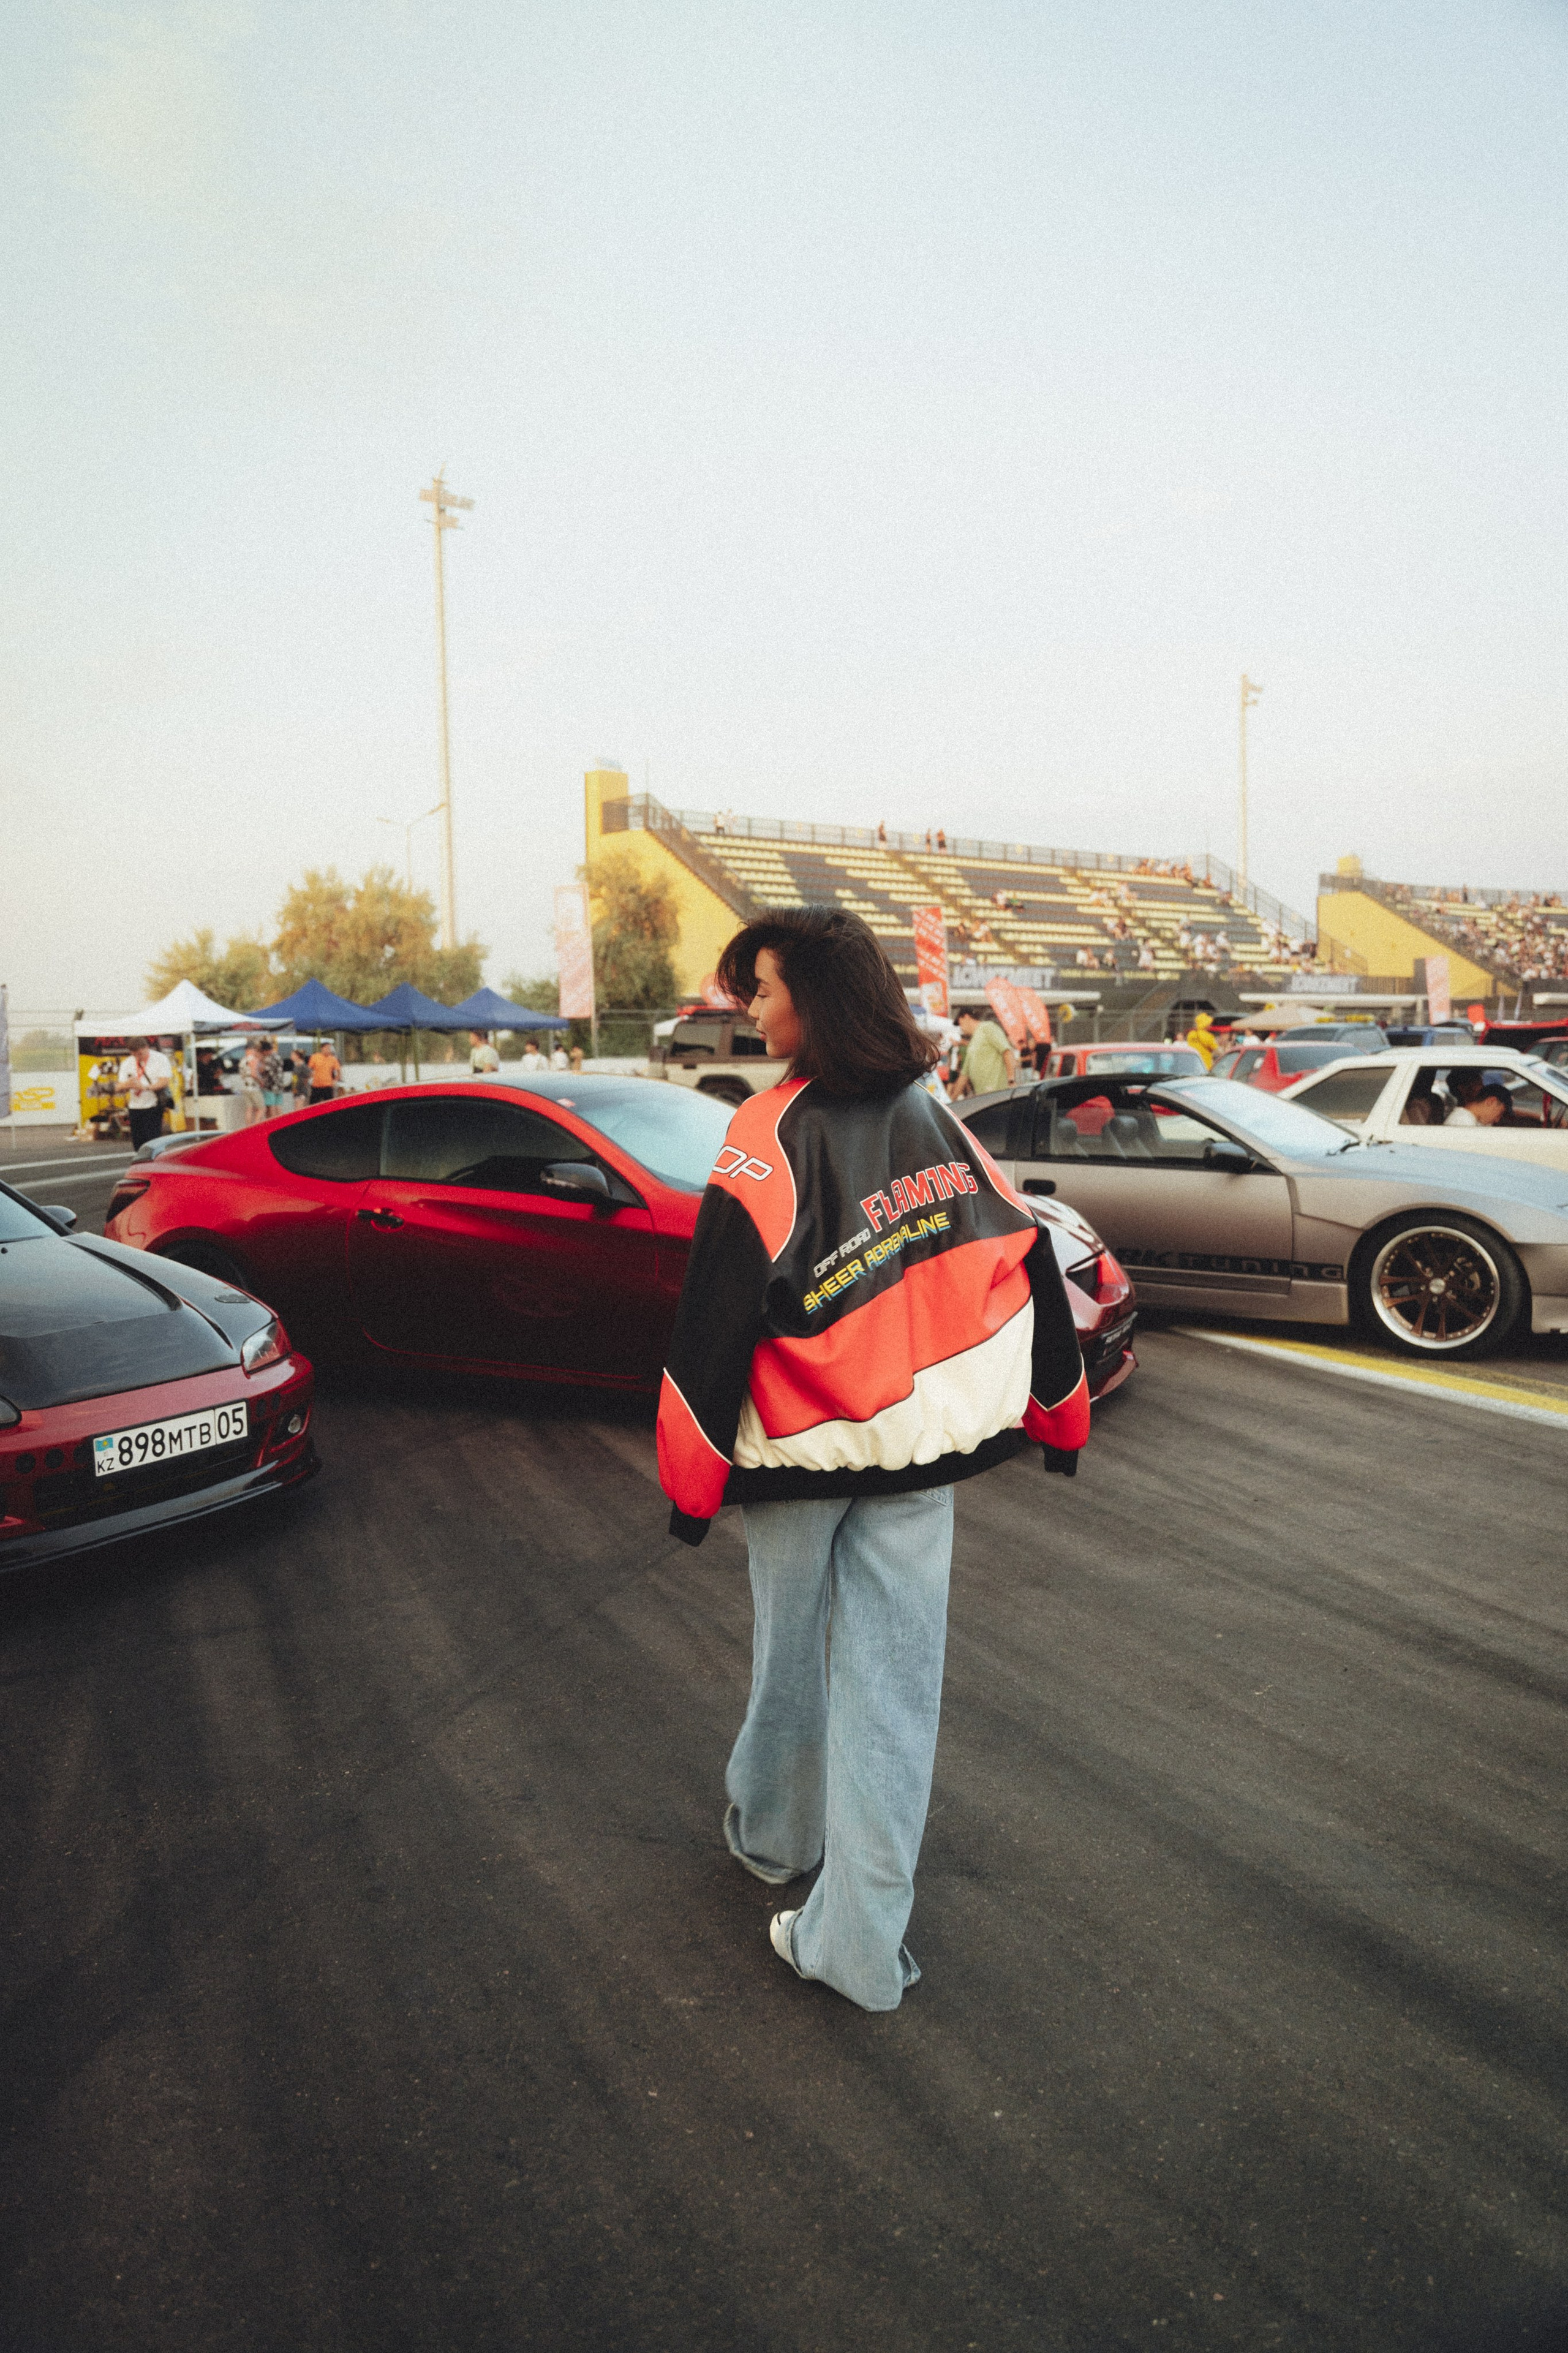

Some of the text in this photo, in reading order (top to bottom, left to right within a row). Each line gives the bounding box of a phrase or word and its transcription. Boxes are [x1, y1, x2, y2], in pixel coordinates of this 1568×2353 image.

[859, 1161, 978, 1233] FLAMING
[813, 1228, 871, 1278] OFF ROAD
[804, 1259, 867, 1315] SHEER
[97, 1457, 115, 1473] KZ
